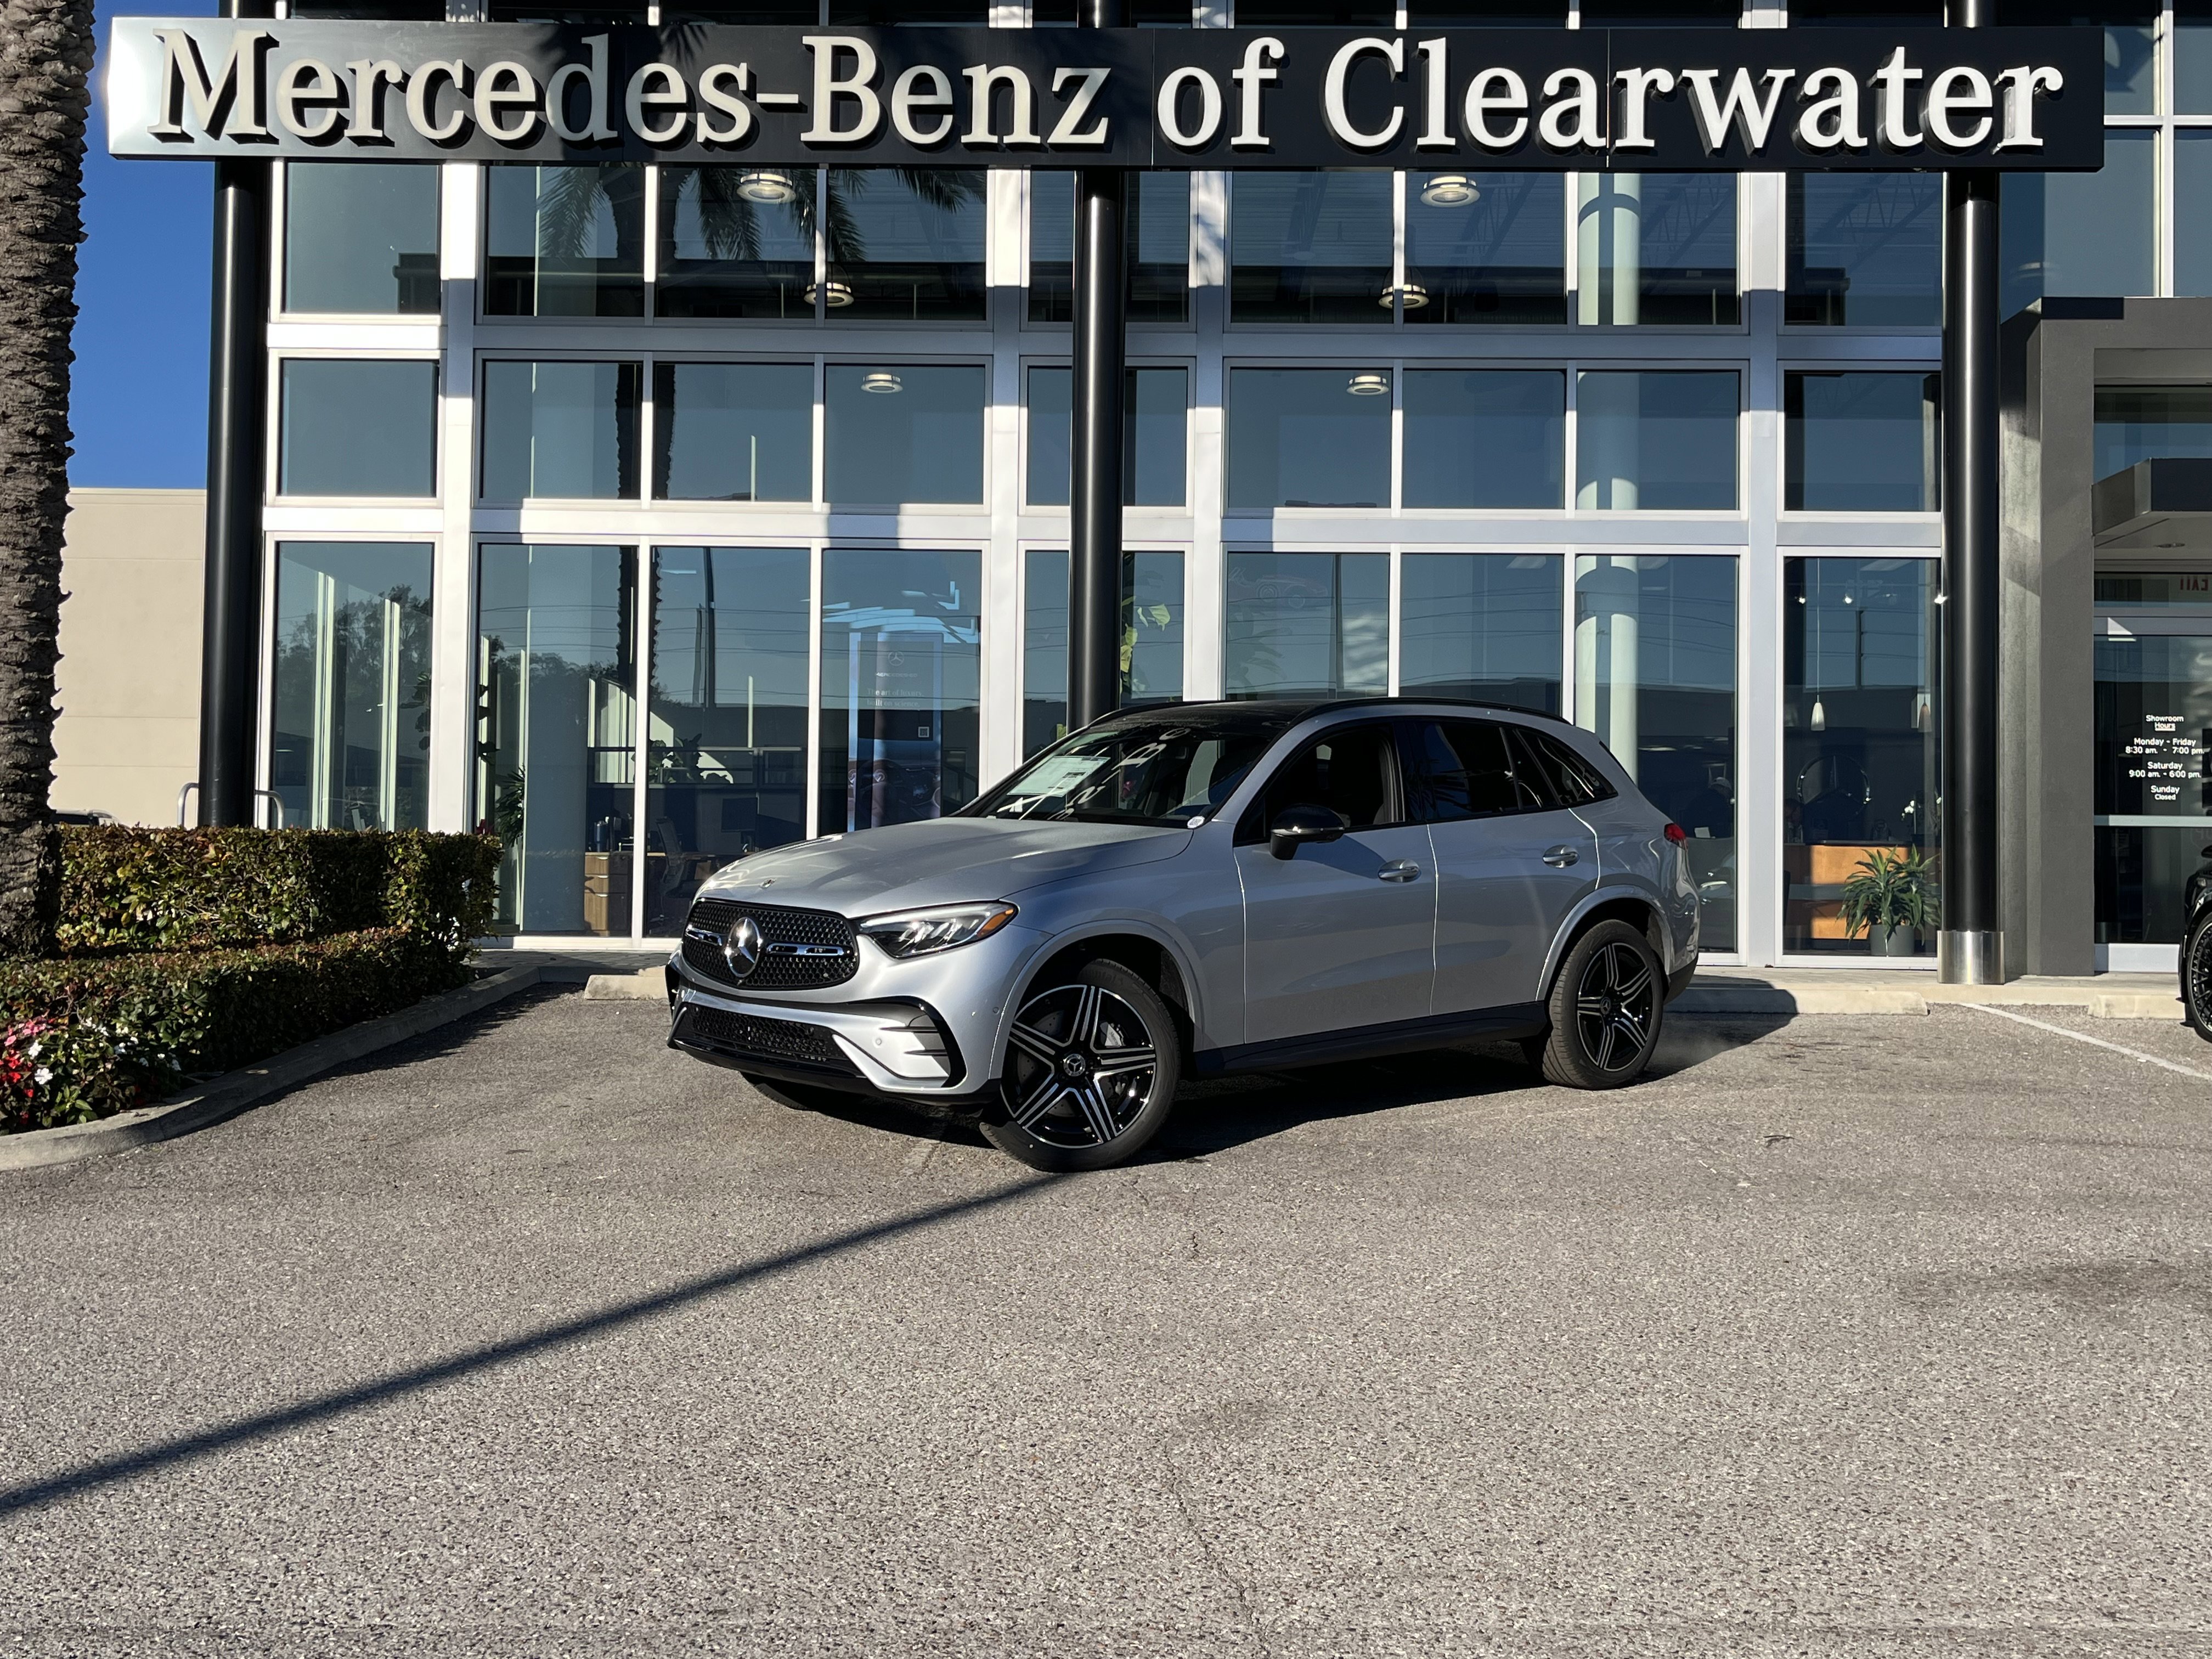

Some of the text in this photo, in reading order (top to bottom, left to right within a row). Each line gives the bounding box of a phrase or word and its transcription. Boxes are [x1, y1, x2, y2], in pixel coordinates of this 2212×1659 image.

[146, 29, 2063, 149] Mercedes-Benz of Clearwater
[2134, 738, 2164, 747] Monday
[2172, 738, 2196, 747] Friday
[2147, 761, 2183, 770] Saturday
[2151, 785, 2180, 794] Sunday
